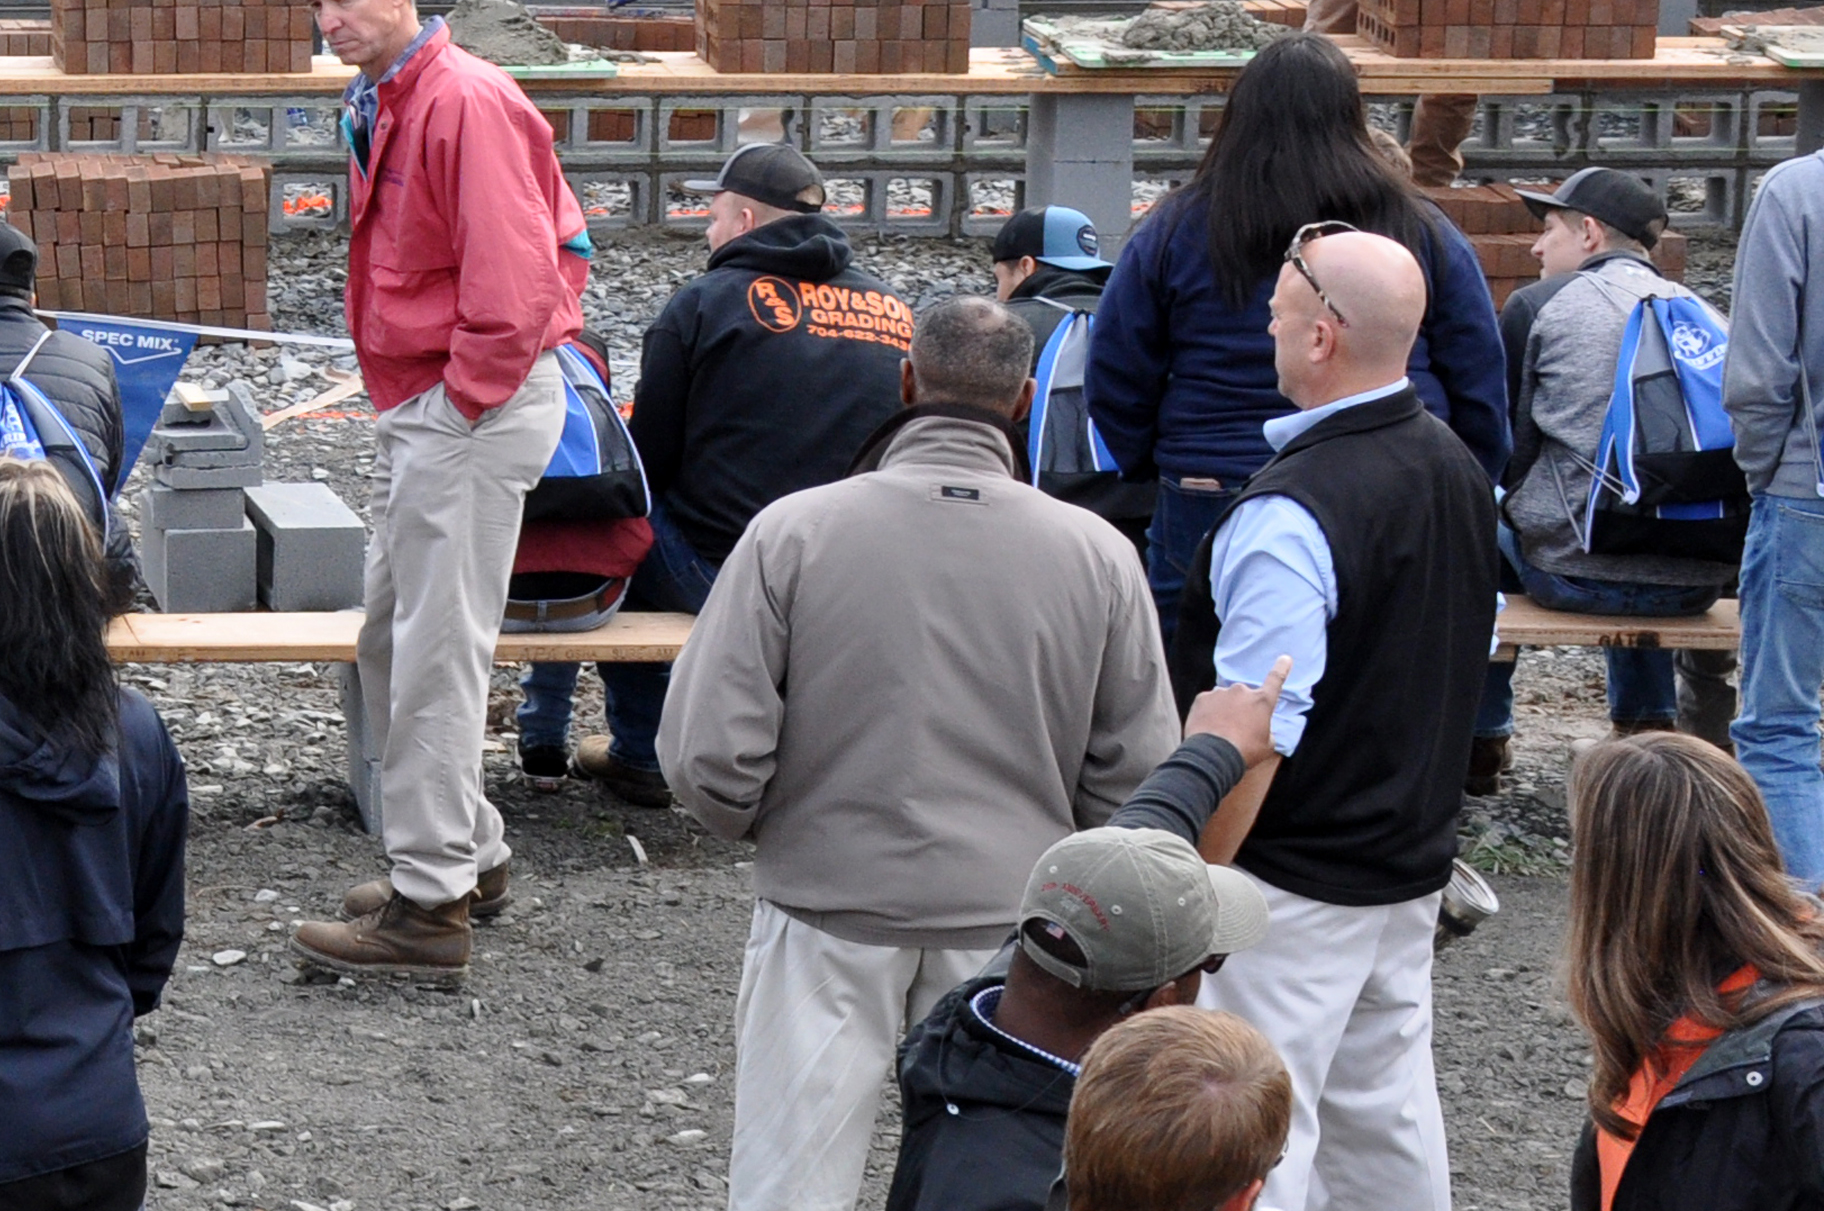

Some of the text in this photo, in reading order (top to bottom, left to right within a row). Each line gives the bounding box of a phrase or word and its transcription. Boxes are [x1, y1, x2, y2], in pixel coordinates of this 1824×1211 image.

[811, 309, 913, 339] GRADING
[81, 329, 174, 351] SPEC MIX
